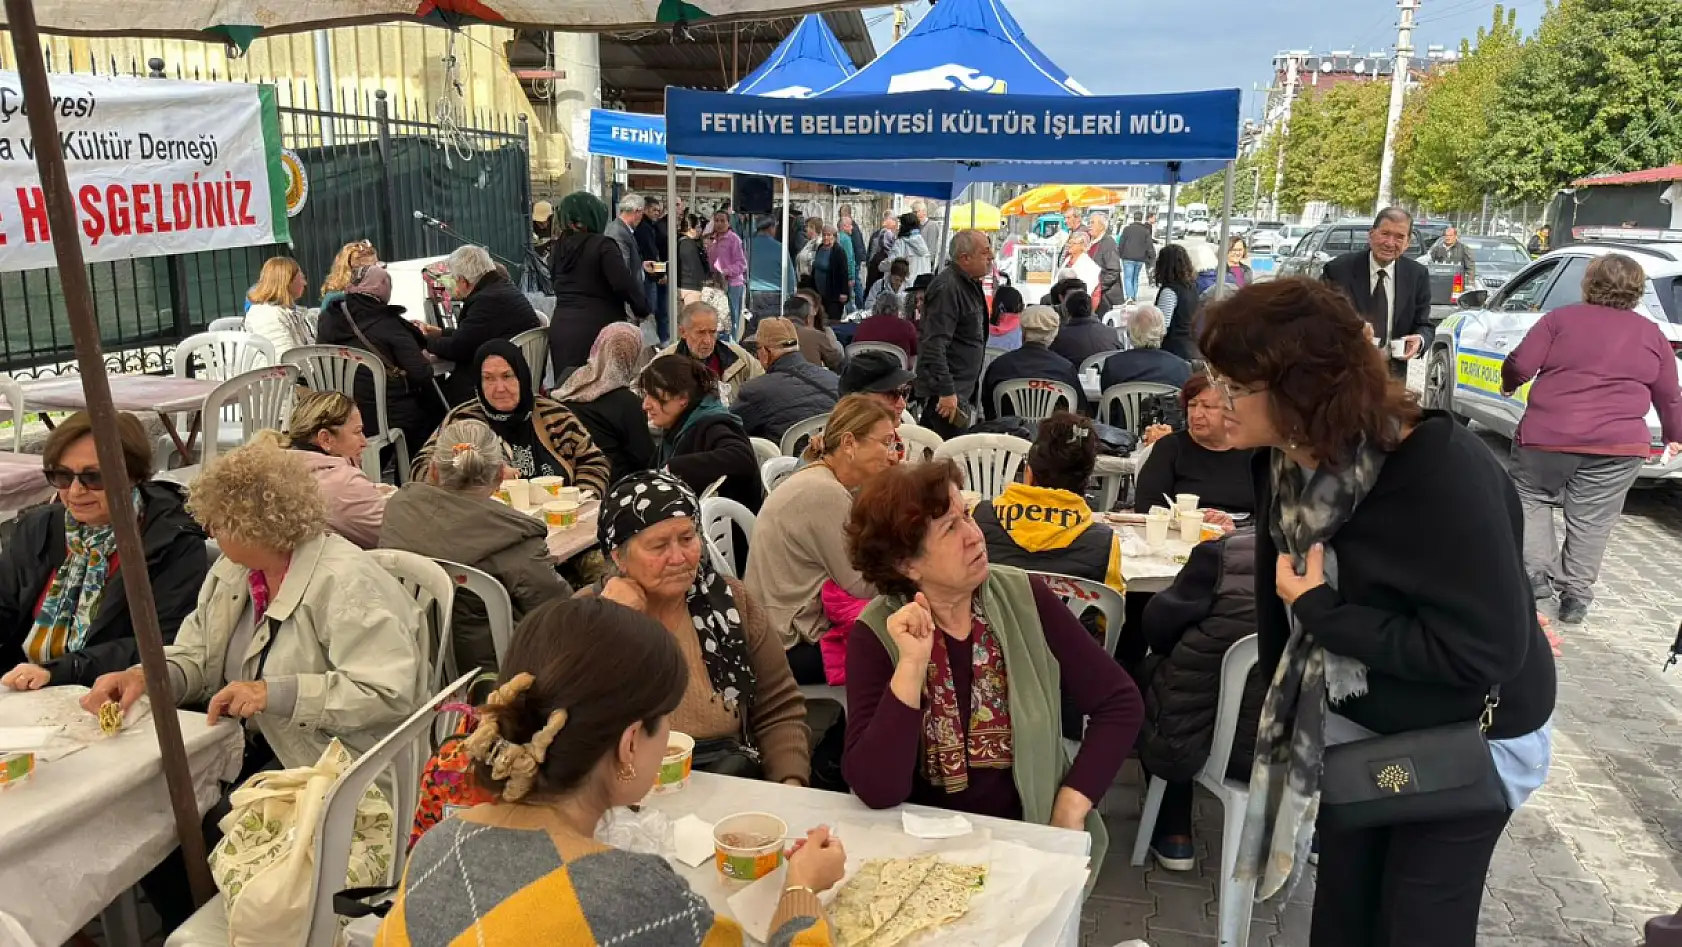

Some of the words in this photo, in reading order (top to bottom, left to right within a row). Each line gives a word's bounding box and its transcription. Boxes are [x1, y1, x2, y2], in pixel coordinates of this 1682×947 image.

[0, 87, 95, 123] Çresi
[611, 126, 666, 146] FETHİY
[701, 109, 794, 135] FETHİYE
[801, 108, 933, 135] BELEDİYESİ
[941, 109, 1036, 135] KÜLTÜR
[1044, 109, 1121, 140] İŞLERİ
[1130, 110, 1191, 135] MÜD.
[59, 130, 133, 161] Kültür
[138, 132, 218, 166] Derneği
[16, 171, 256, 246] HŞGELDİNİZ
